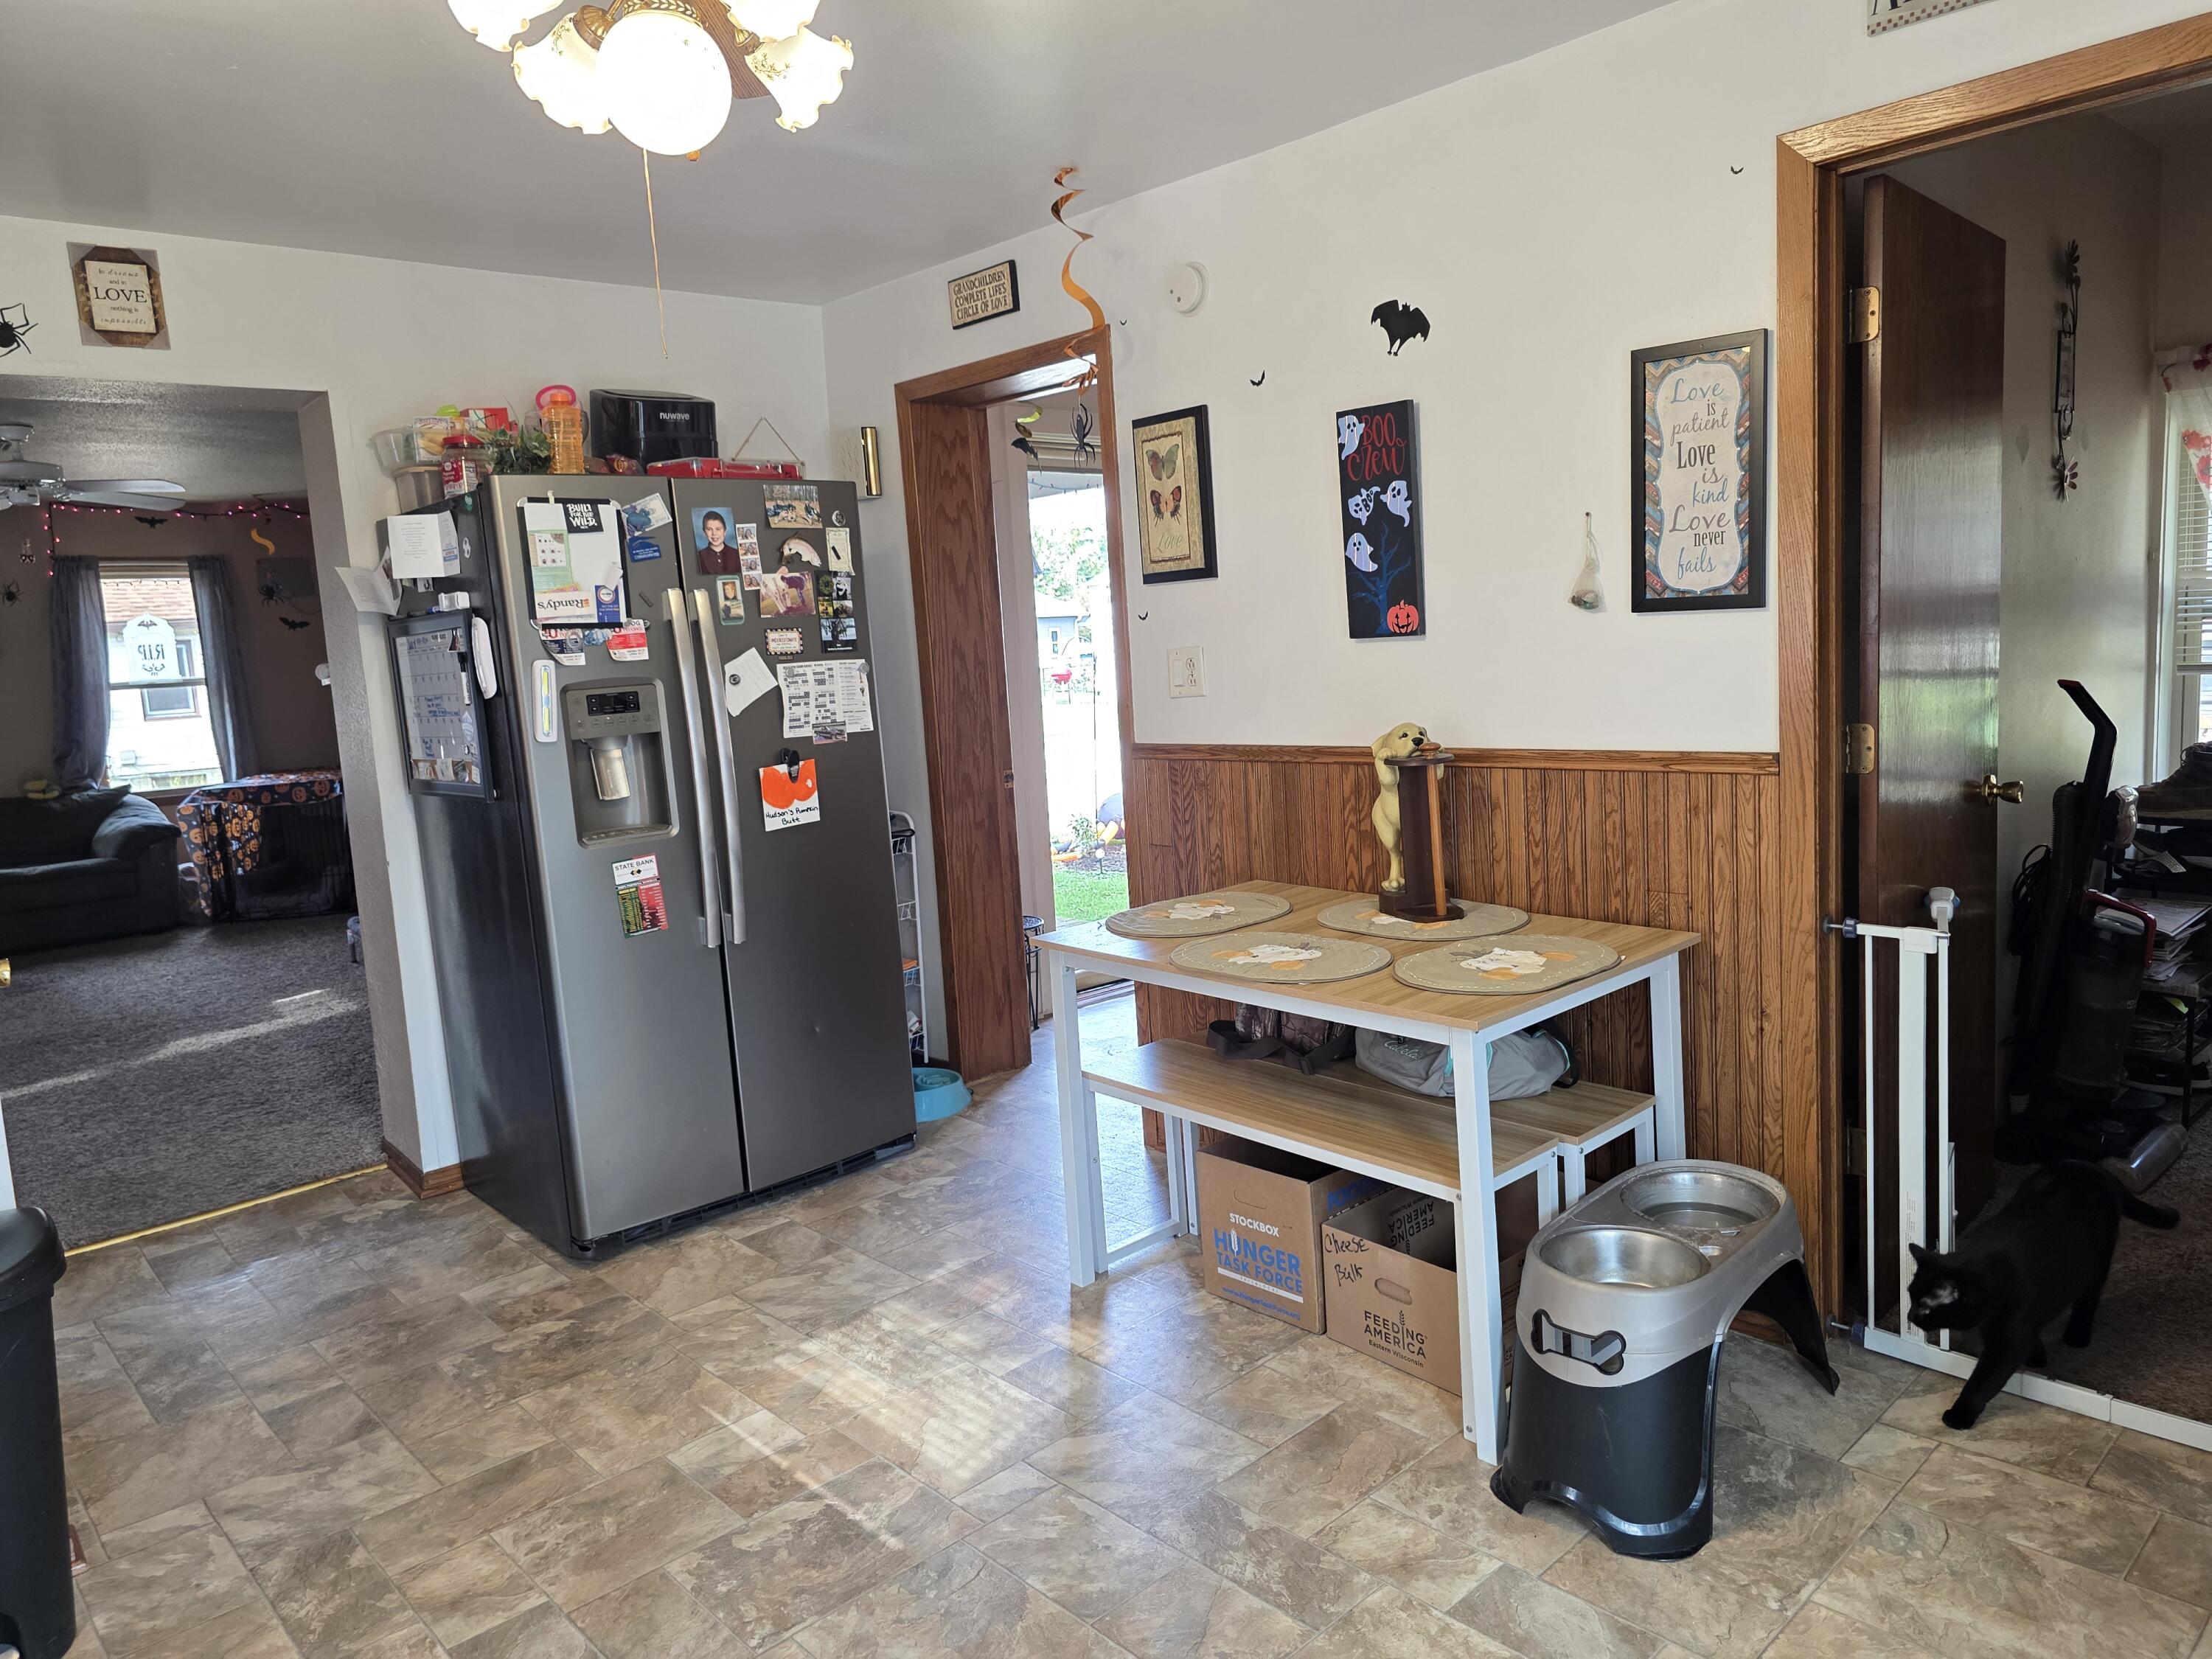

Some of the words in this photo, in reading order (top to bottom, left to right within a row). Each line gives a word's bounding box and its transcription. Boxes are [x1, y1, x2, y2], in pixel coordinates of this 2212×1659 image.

[108, 268, 139, 277] dreams
[954, 271, 1005, 296] GRANDCHILDREN
[94, 287, 147, 303] LOVE
[956, 289, 987, 307] COMPLETE
[988, 282, 1006, 297] LIFE'S
[957, 305, 978, 319] CIRCLE
[981, 300, 989, 313] OF
[991, 295, 1007, 310] LOVE
[100, 317, 147, 325] impossible
[111, 306, 133, 314] nothing
[1670, 378, 1724, 404] Love
[659, 411, 690, 420] nuwave
[1707, 399, 1717, 417] is
[1360, 412, 1396, 447] BOO
[1670, 407, 1730, 447] patient
[1677, 441, 1716, 470] Love
[1702, 467, 1724, 484] is
[1692, 478, 1729, 508] kind
[566, 503, 593, 513] BUILT
[1669, 504, 1731, 533] Love
[1156, 529, 1184, 554] Love
[1694, 530, 1726, 547] never
[1677, 546, 1717, 580] fails
[538, 599, 585, 611] Randy's
[765, 810, 793, 818] Hudson's
[782, 817, 801, 825] Butt
[615, 862, 635, 872] STATE
[636, 858, 655, 866] BANK
[1229, 1212, 1280, 1238] STOCKBOX
[1388, 1200, 1434, 1234] AMERICA
[1391, 1214, 1435, 1248] FEEDING
[1213, 1228, 1301, 1277] HUNGER
[1217, 1251, 1251, 1276] TASK
[1255, 1265, 1304, 1294] FORCE
[1364, 1310, 1426, 1345] FEEDING
[1363, 1324, 1427, 1360] AMERICA
[1368, 1339, 1391, 1354] Eastern
[1392, 1350, 1424, 1368] Wisconsin
